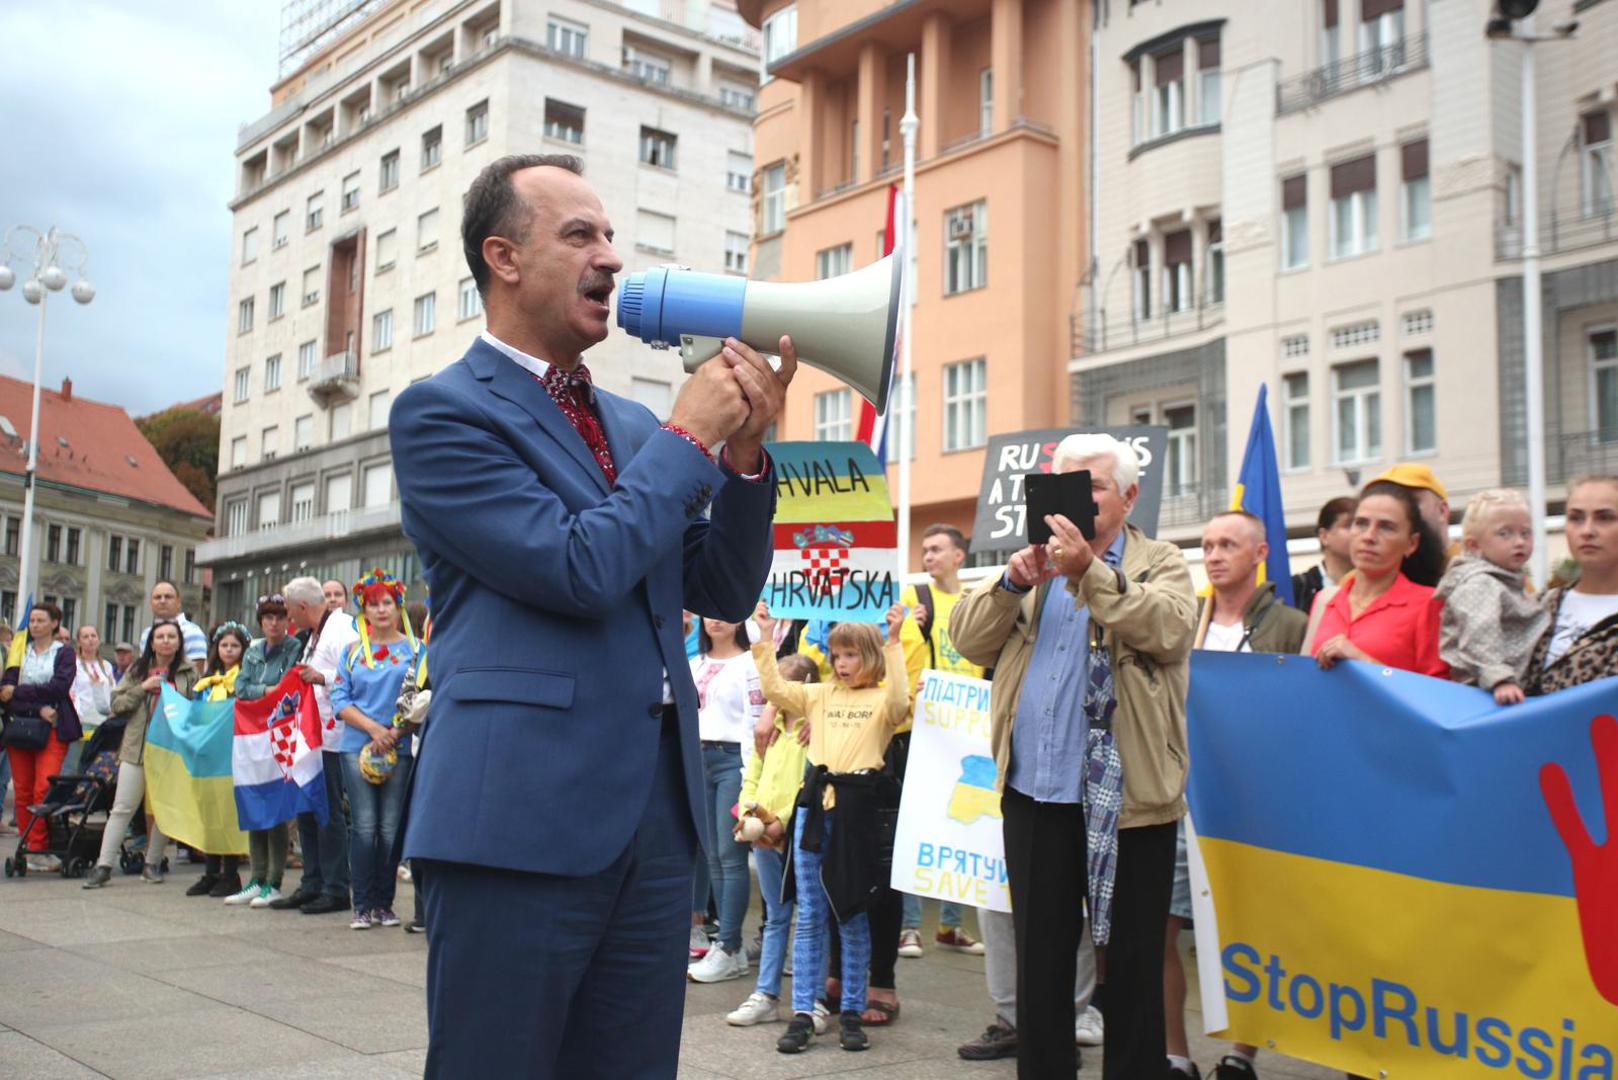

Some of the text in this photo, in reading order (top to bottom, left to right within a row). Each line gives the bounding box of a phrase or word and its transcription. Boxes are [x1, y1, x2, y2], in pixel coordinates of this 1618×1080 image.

[777, 457, 870, 499] HVALA
[771, 567, 894, 610] HRVATSKA
[913, 867, 989, 905] SAVE
[1221, 942, 1614, 1080] StopRussia
